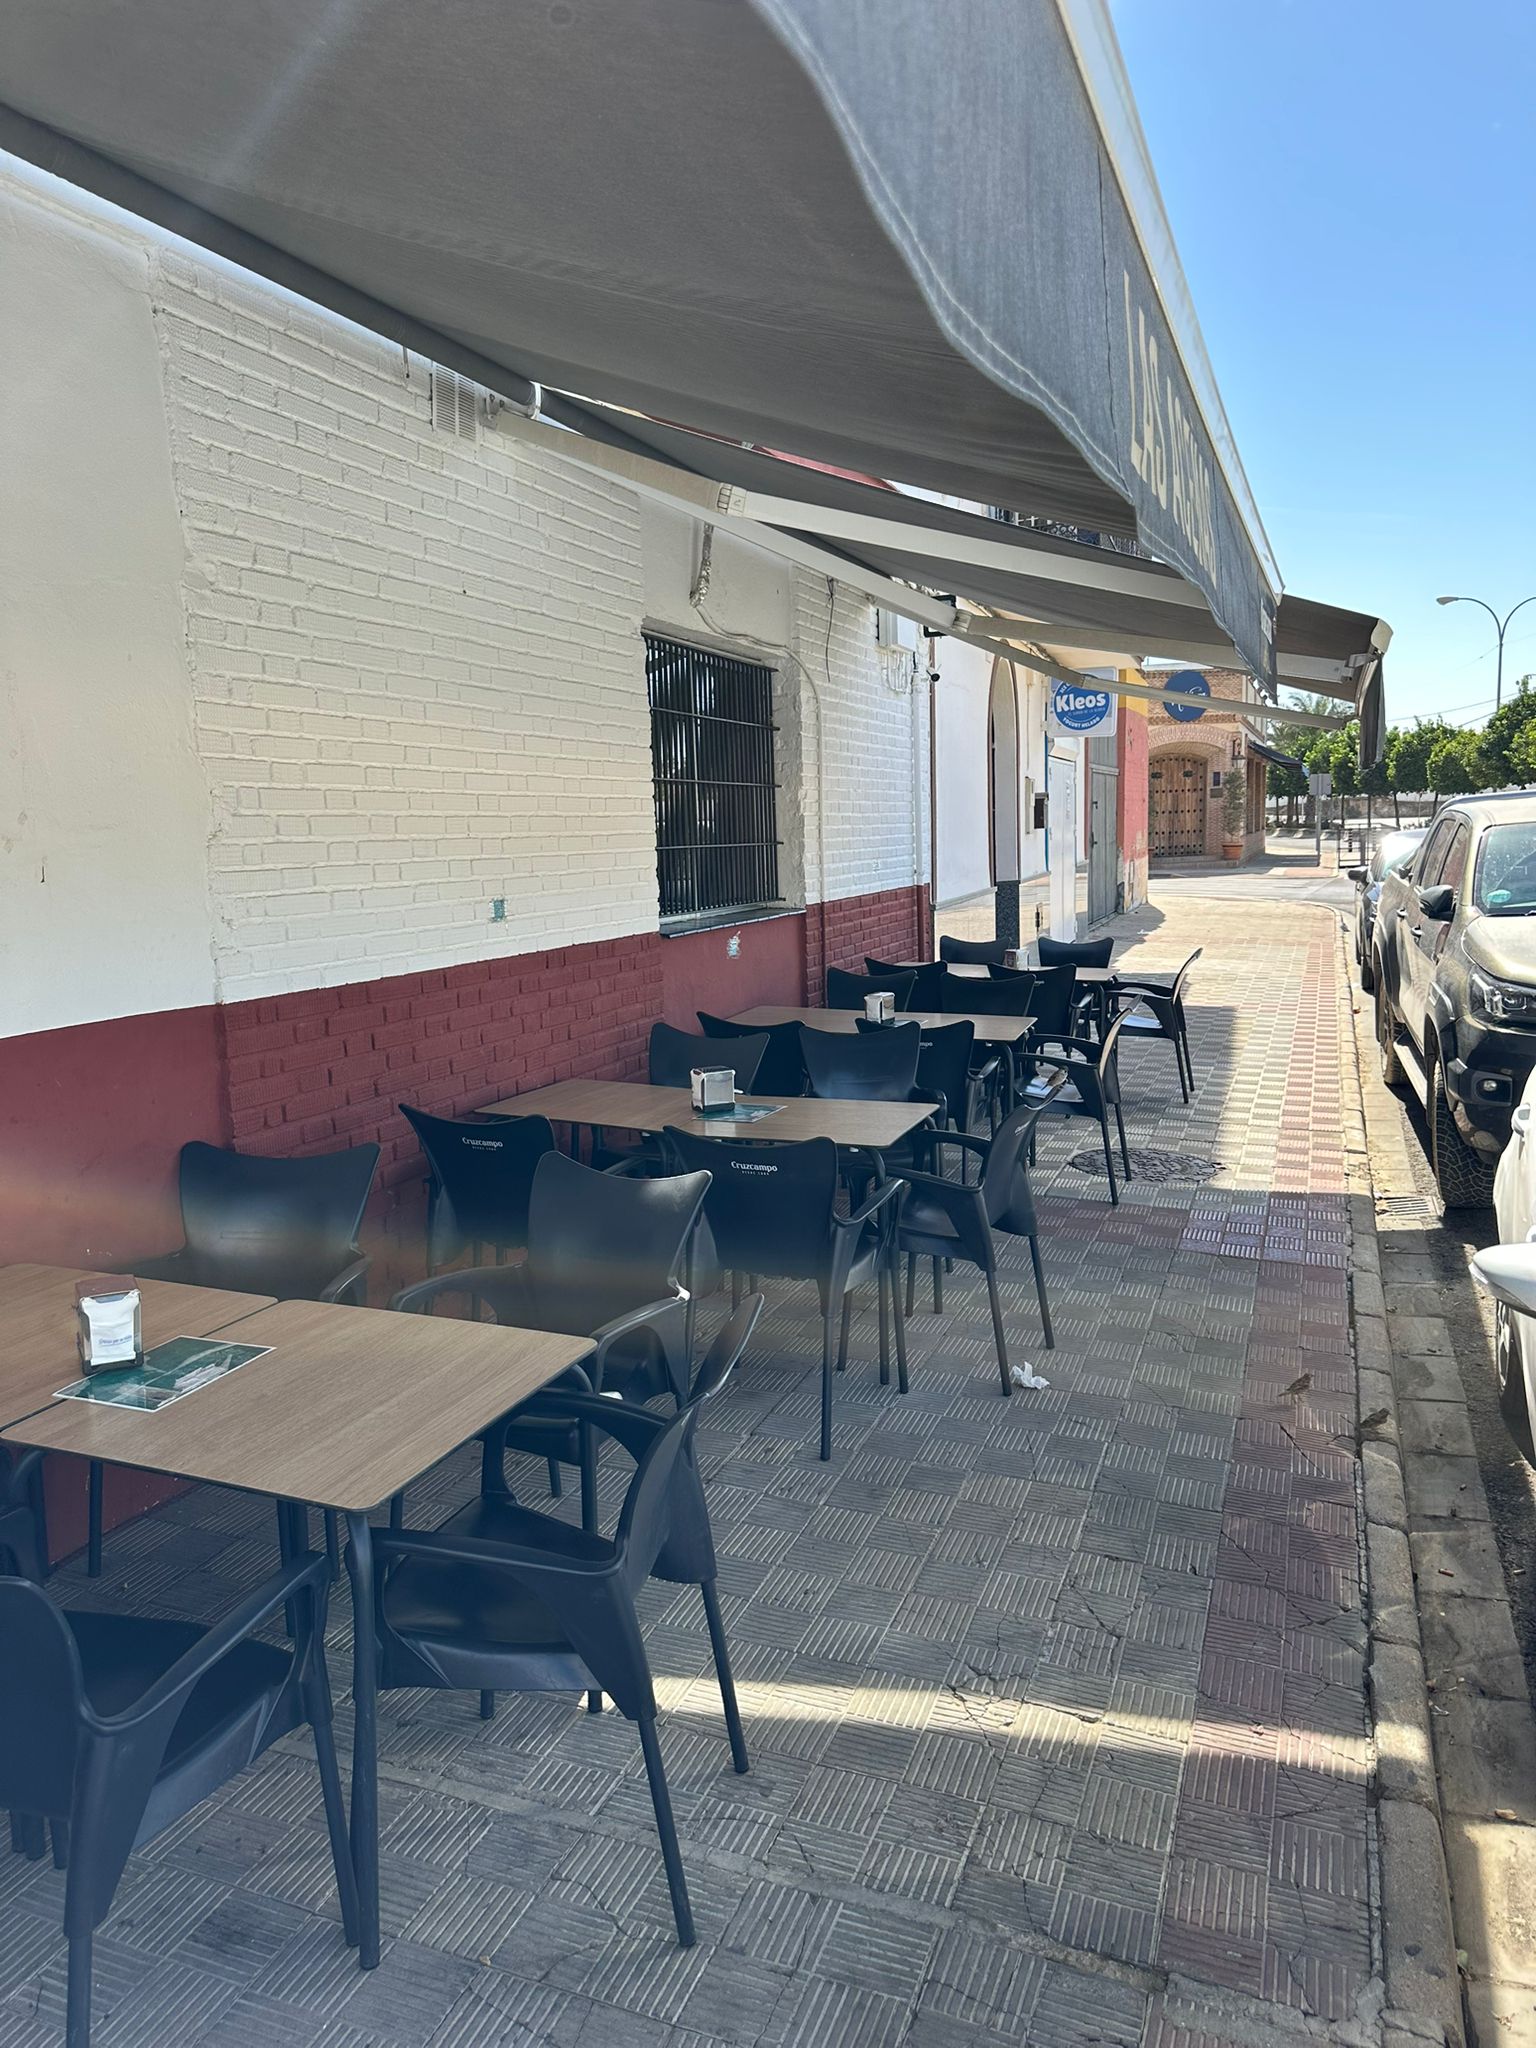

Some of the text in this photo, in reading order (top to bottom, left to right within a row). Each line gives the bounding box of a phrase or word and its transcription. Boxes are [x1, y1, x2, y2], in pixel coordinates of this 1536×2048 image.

[1123, 268, 1167, 511] LAS
[1055, 693, 1106, 713] Kleos
[462, 1136, 504, 1149] Cruzcampo
[730, 1160, 778, 1173] Cruzcampo
